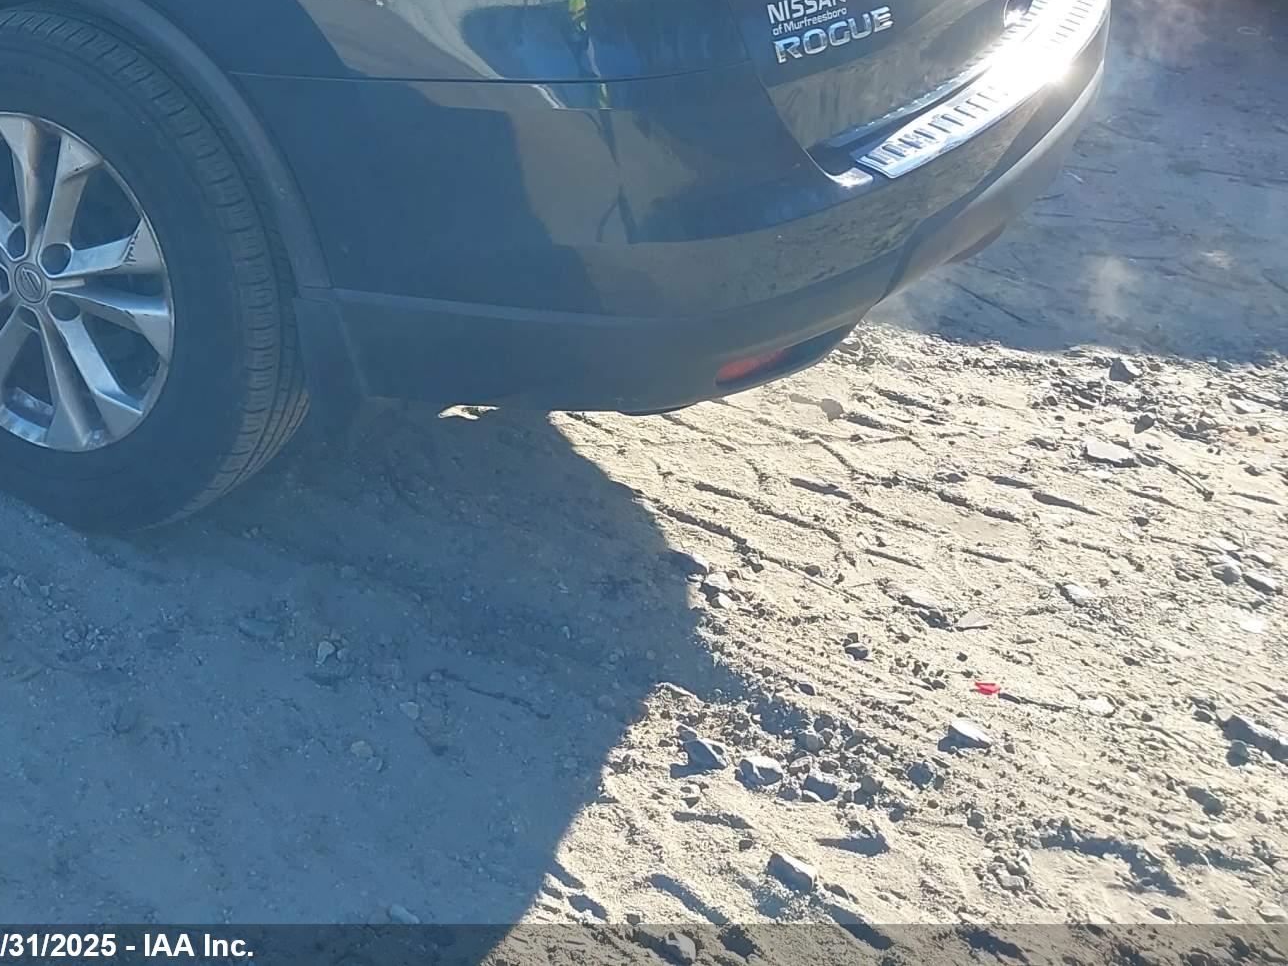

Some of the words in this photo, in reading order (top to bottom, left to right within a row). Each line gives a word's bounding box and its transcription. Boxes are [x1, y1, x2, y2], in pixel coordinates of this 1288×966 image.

[772, 24, 784, 36] of
[784, 7, 847, 34] Murfreesboro
[773, 6, 894, 64] ROGUE
